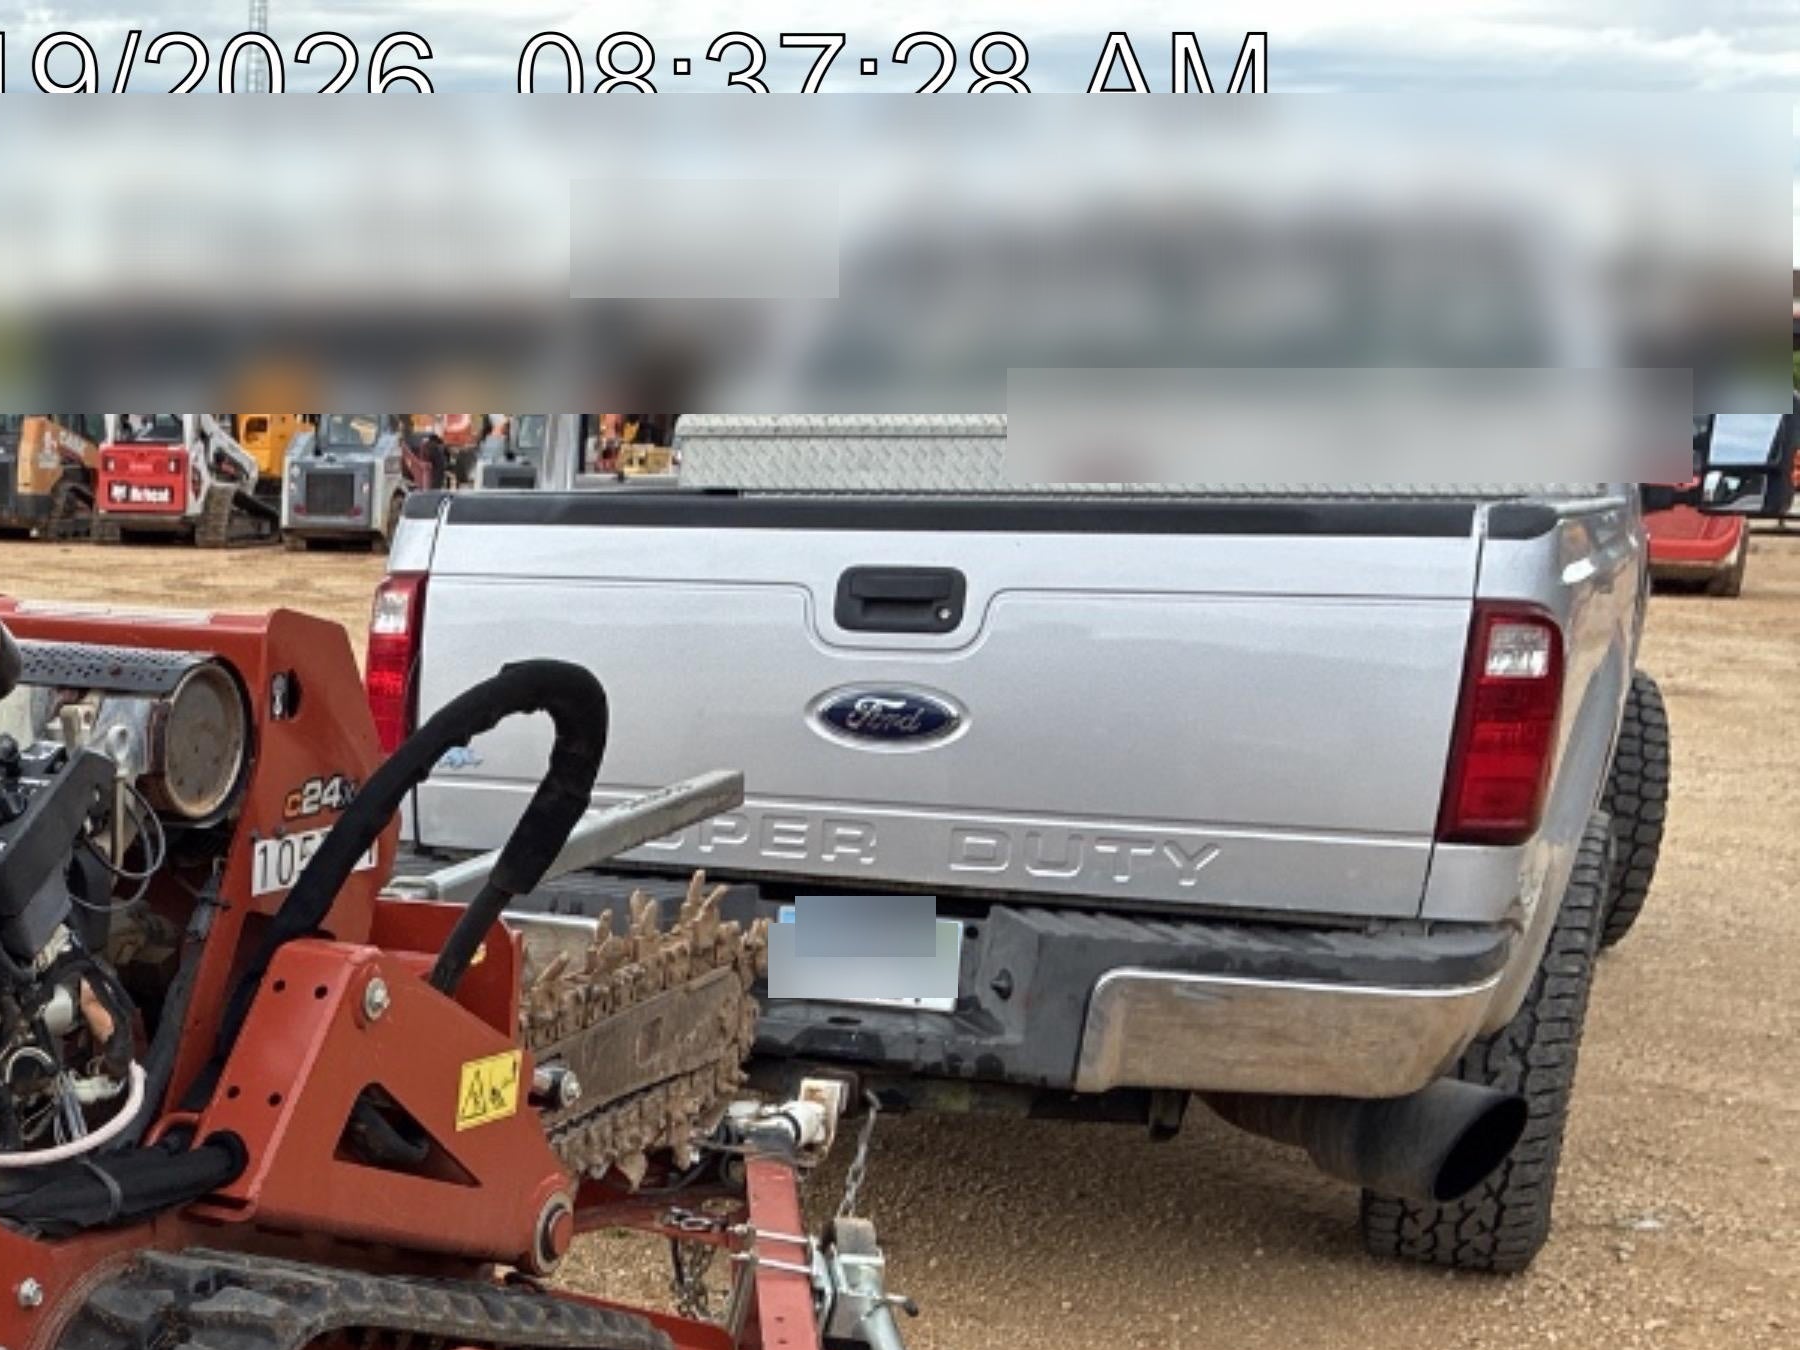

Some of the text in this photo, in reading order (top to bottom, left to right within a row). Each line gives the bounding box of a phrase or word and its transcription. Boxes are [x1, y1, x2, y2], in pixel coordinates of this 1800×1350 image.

[846, 697, 926, 732] Ford
[644, 811, 1222, 887] PER DUTY
